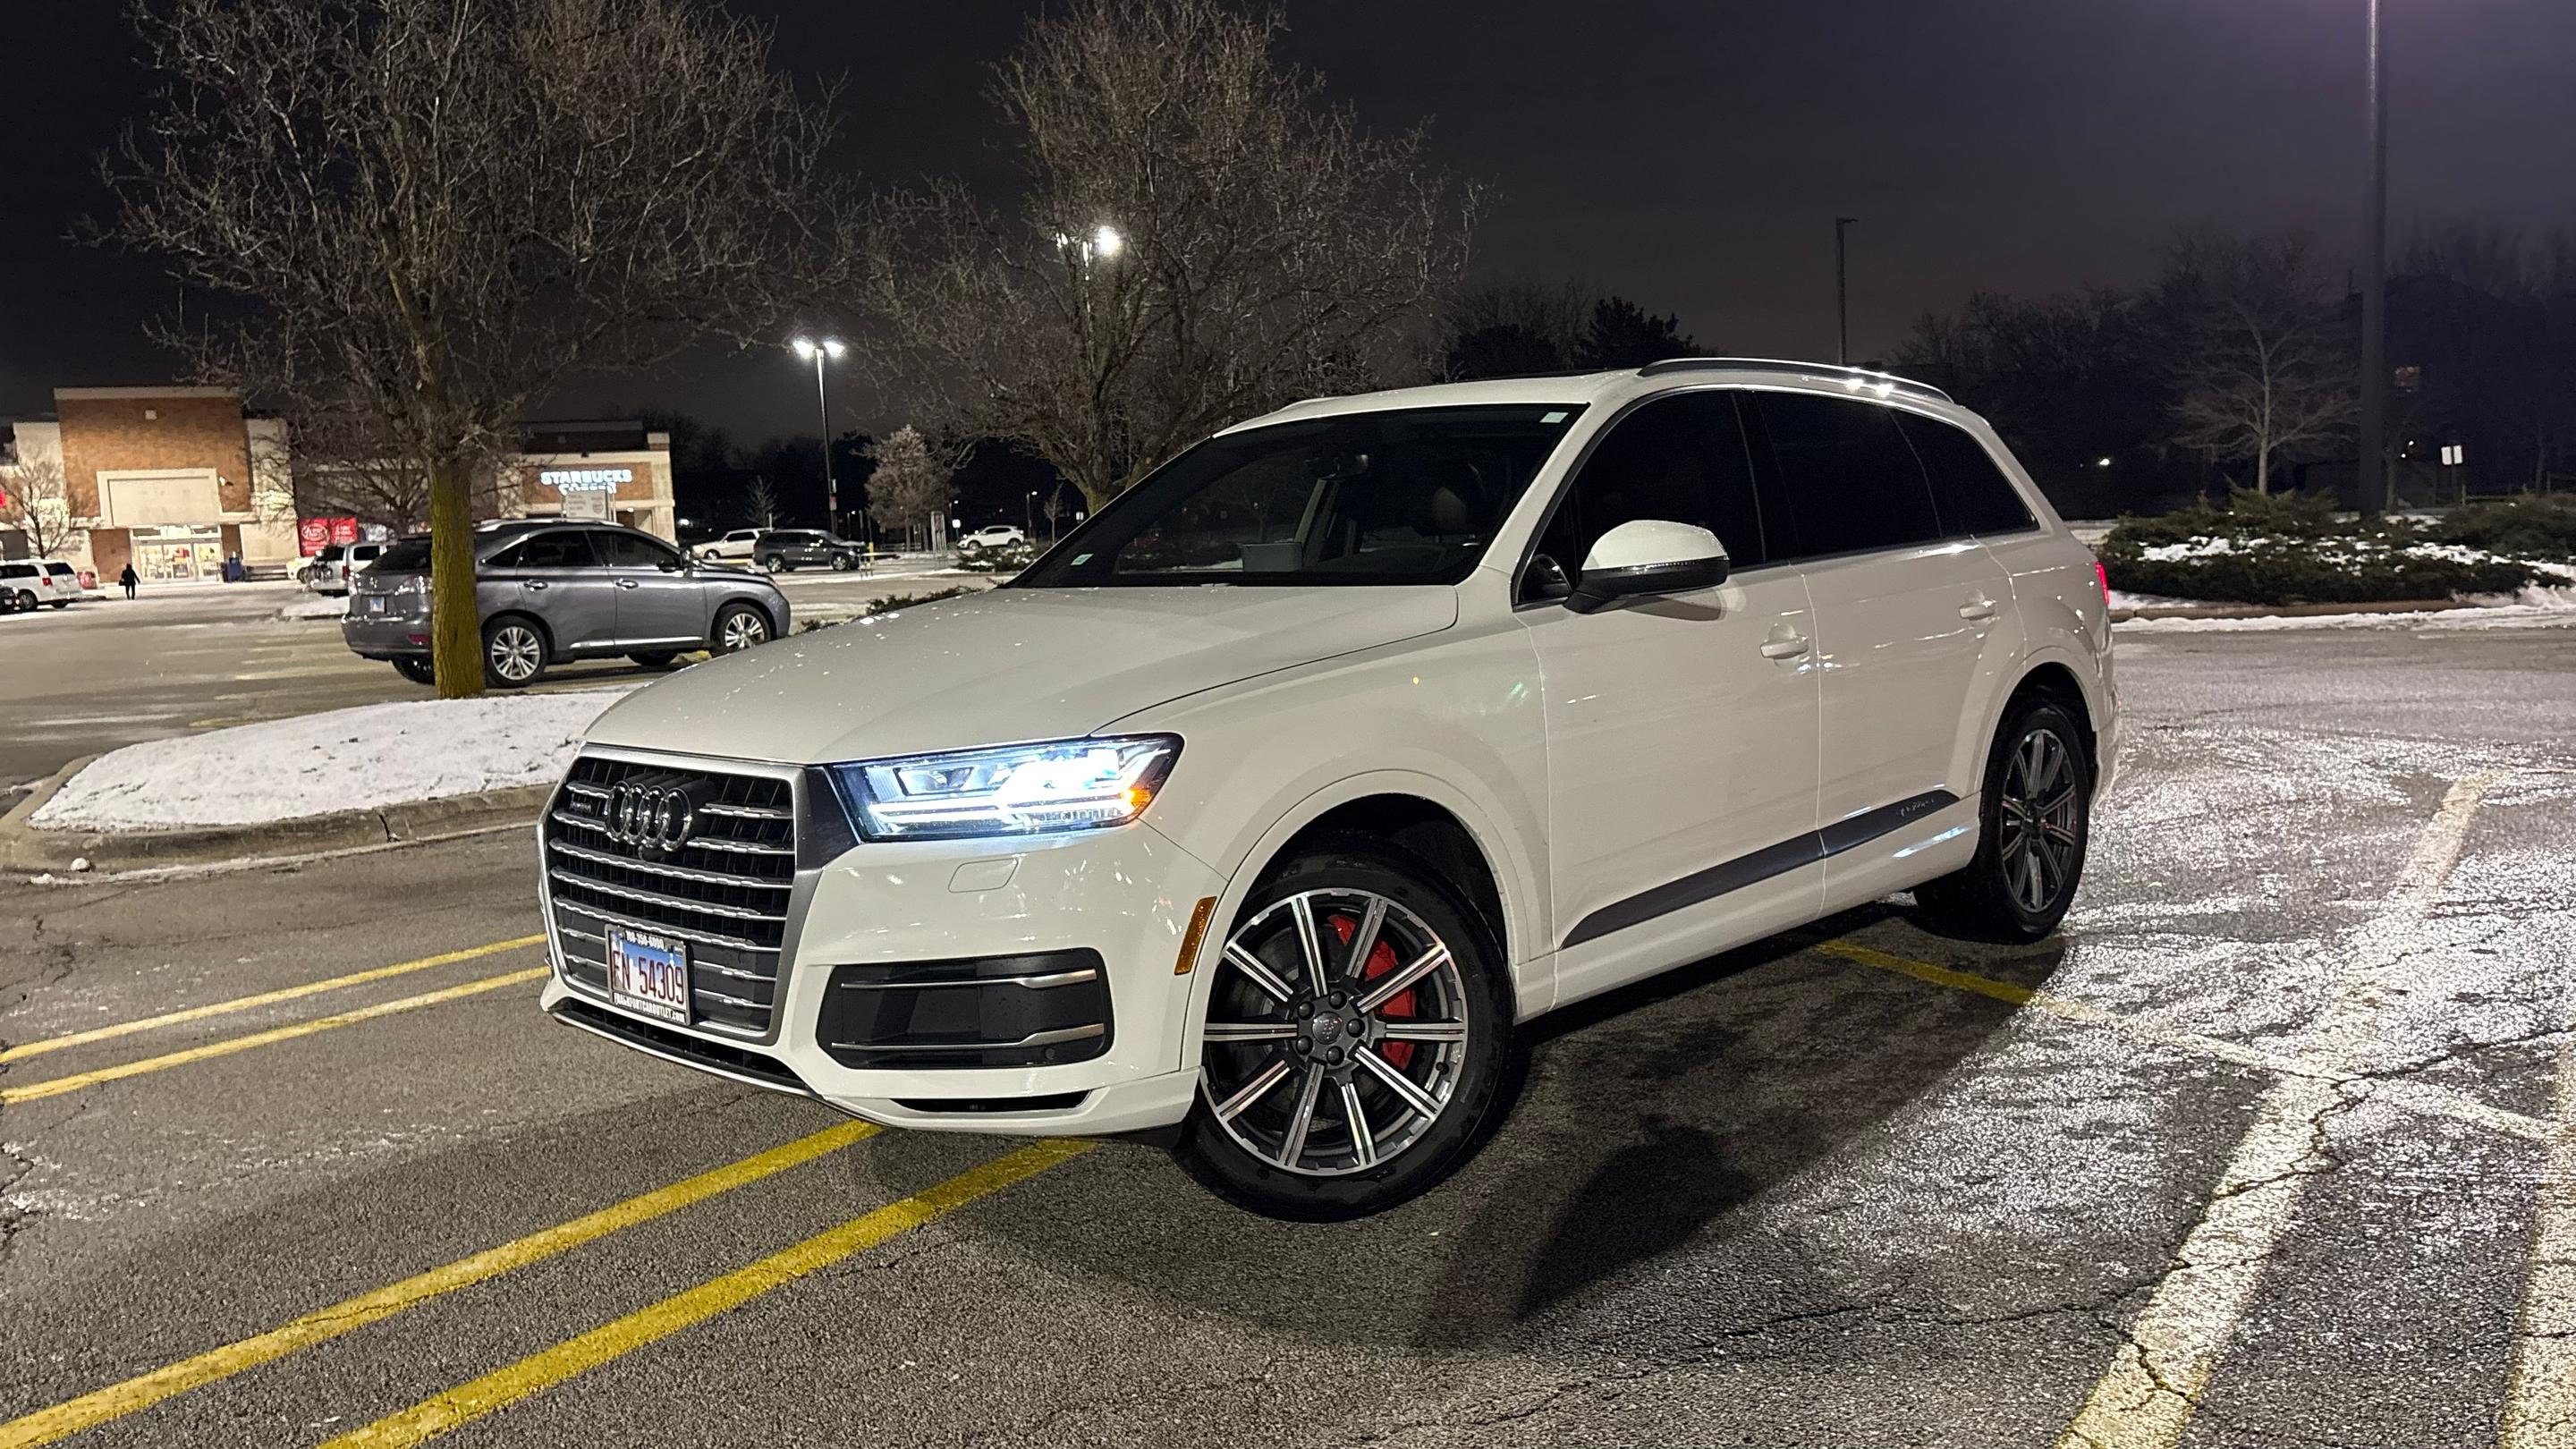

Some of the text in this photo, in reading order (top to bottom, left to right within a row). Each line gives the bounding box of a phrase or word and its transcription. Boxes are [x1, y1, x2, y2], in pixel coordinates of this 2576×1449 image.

[540, 470, 632, 485] STARBUCKS
[613, 951, 684, 1004] FN 54309
